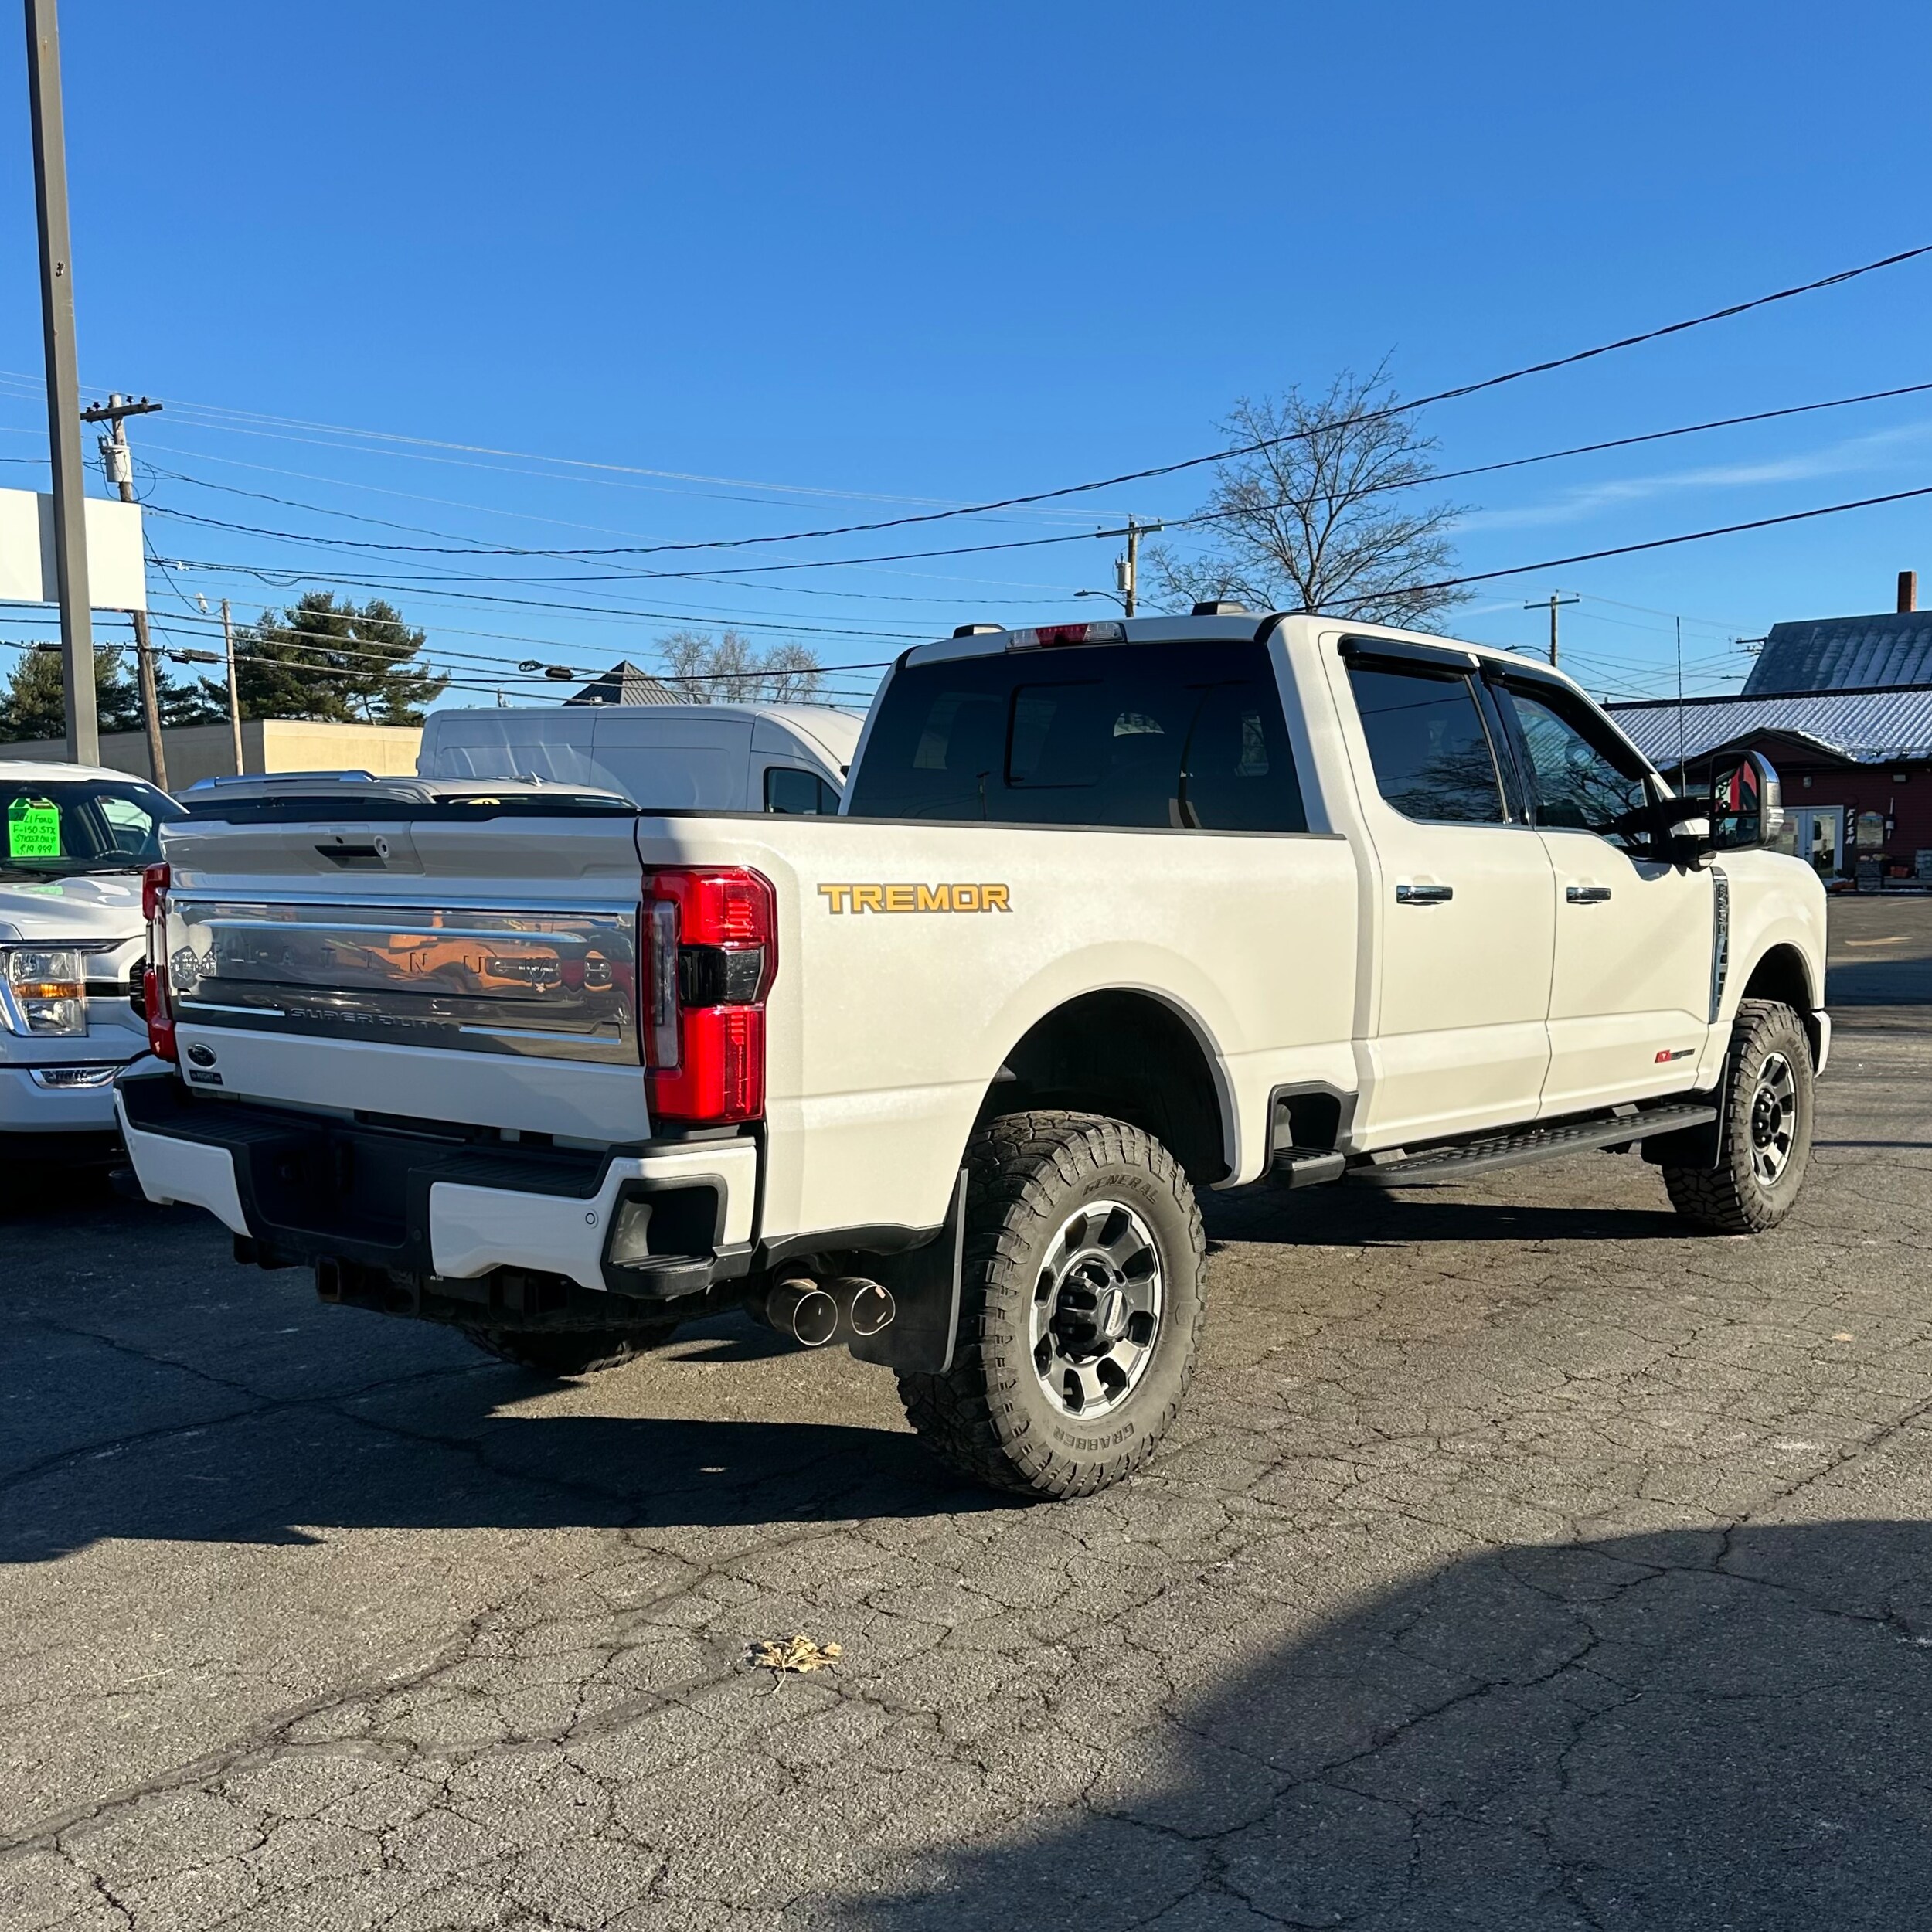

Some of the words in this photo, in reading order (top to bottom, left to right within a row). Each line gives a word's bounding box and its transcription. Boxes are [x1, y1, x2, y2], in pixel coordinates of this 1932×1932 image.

[13, 824, 38, 834] F-150
[39, 825, 56, 835] STX
[1845, 808, 1855, 845] FISH
[817, 883, 1014, 915] TREMOR
[290, 1007, 374, 1025] SUPER
[379, 1014, 449, 1031] DUTY
[1083, 1174, 1158, 1205] GENERAL
[1053, 1422, 1134, 1451] GRABBER
